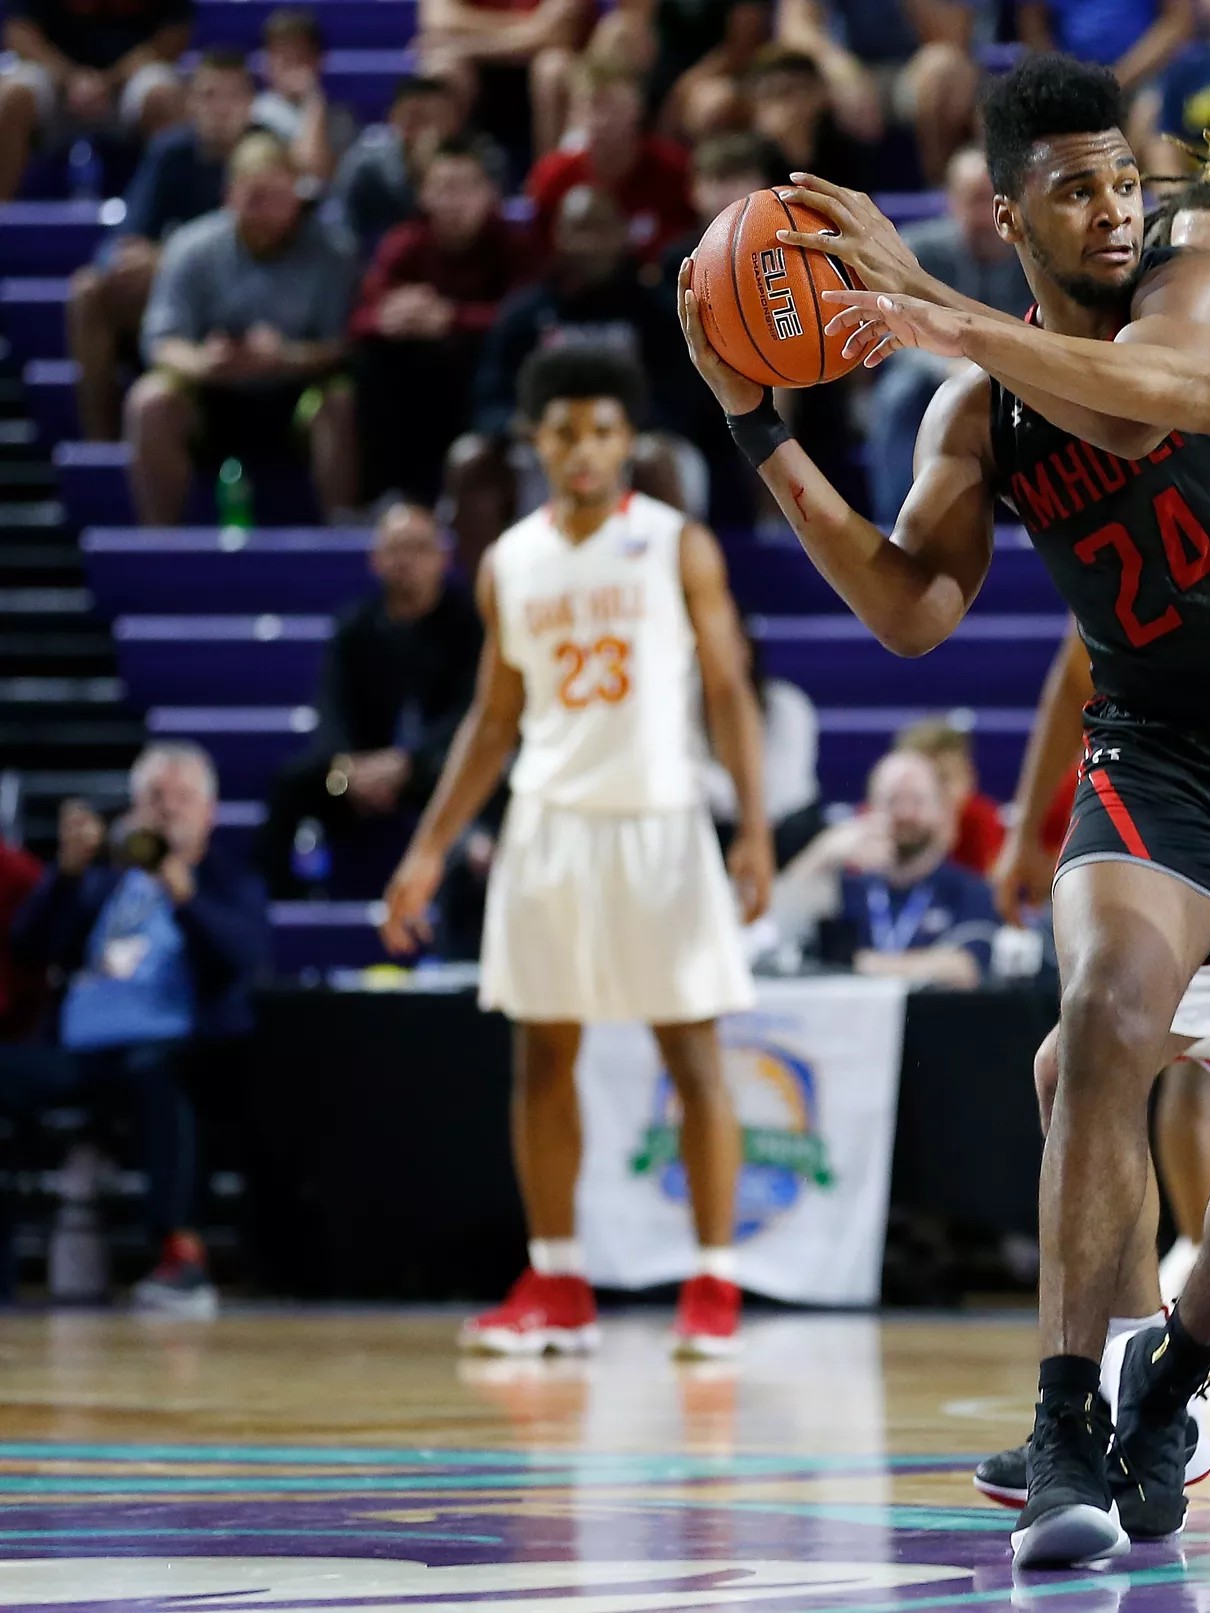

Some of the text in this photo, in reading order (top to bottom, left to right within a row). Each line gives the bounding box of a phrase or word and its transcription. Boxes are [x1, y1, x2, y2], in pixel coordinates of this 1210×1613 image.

[751, 253, 779, 342] CHAMPIONSHIP
[760, 247, 803, 339] ELITE
[553, 634, 632, 711] 23
